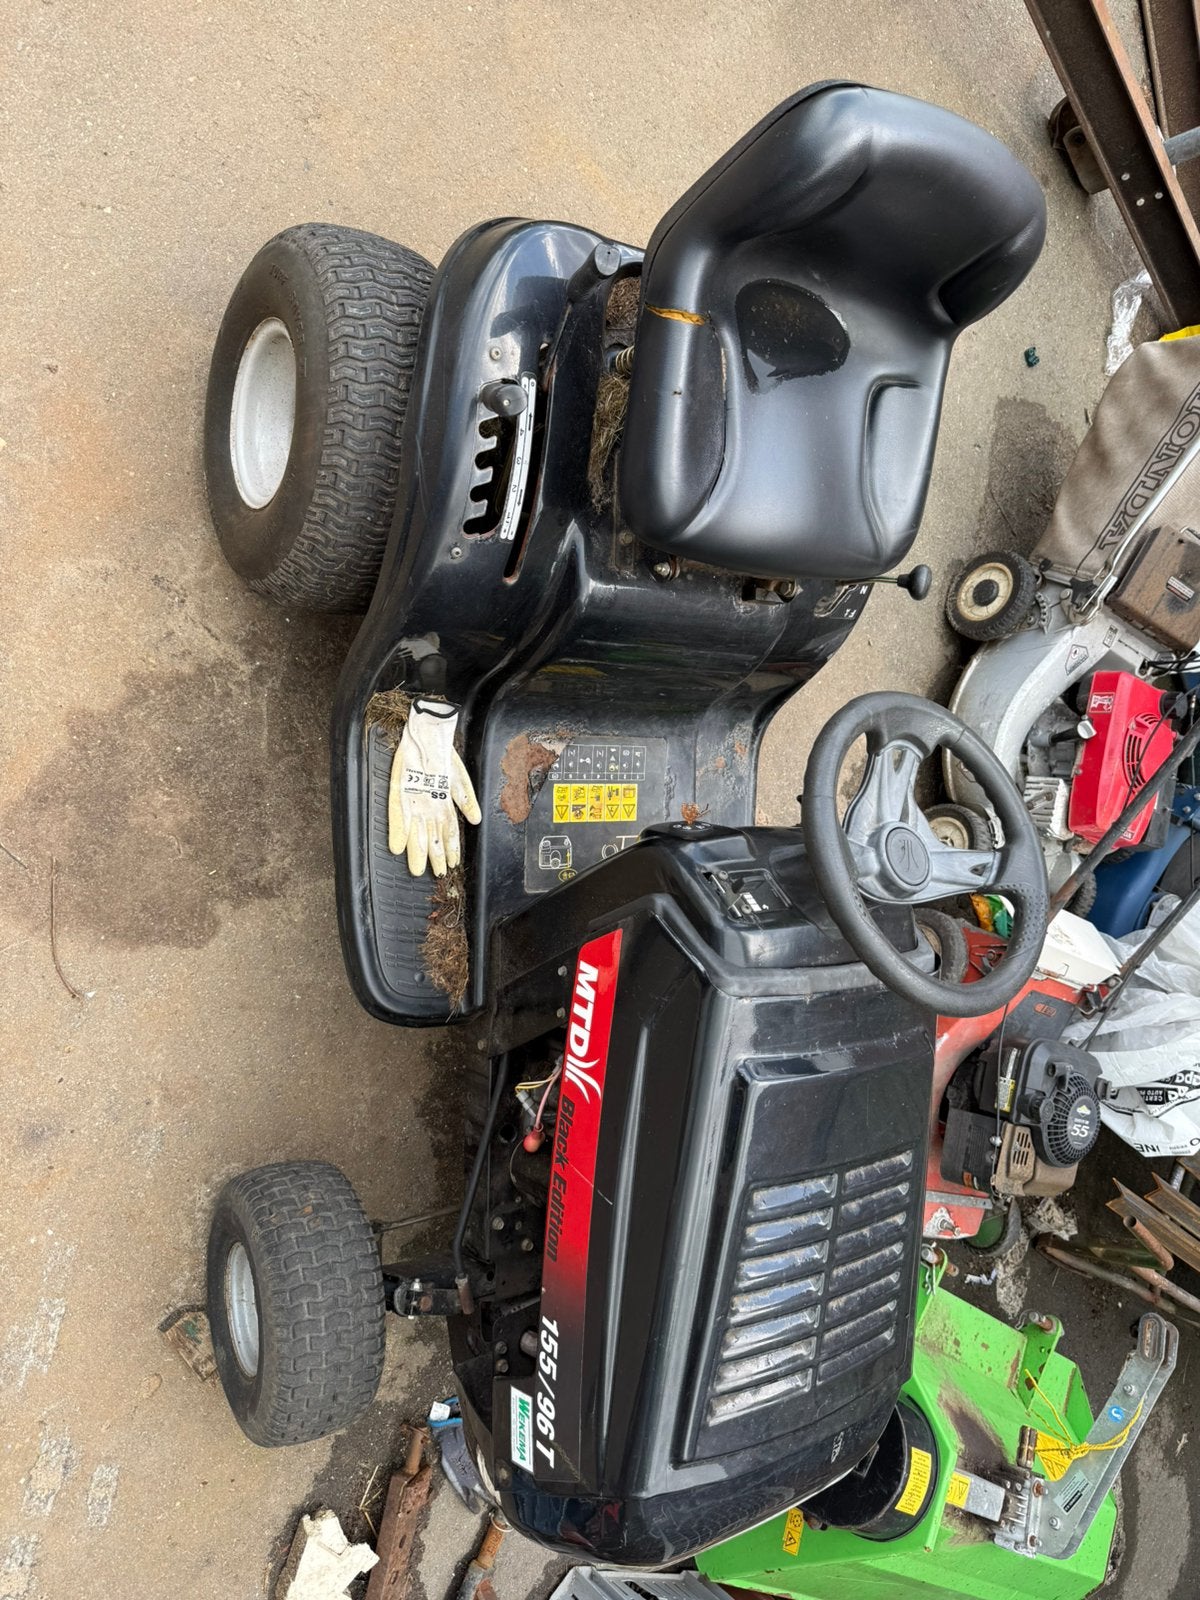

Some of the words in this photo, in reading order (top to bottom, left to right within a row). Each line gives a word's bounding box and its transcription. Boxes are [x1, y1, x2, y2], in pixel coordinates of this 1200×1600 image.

[431, 791, 447, 800] GS
[569, 960, 599, 1058] MTD
[555, 1094, 576, 1172] Black
[1071, 1124, 1090, 1138] 55
[546, 1170, 568, 1263] Edition
[536, 1315, 559, 1441] 155/96
[518, 1397, 530, 1462] WEKEMA
[536, 1440, 555, 1469] T
